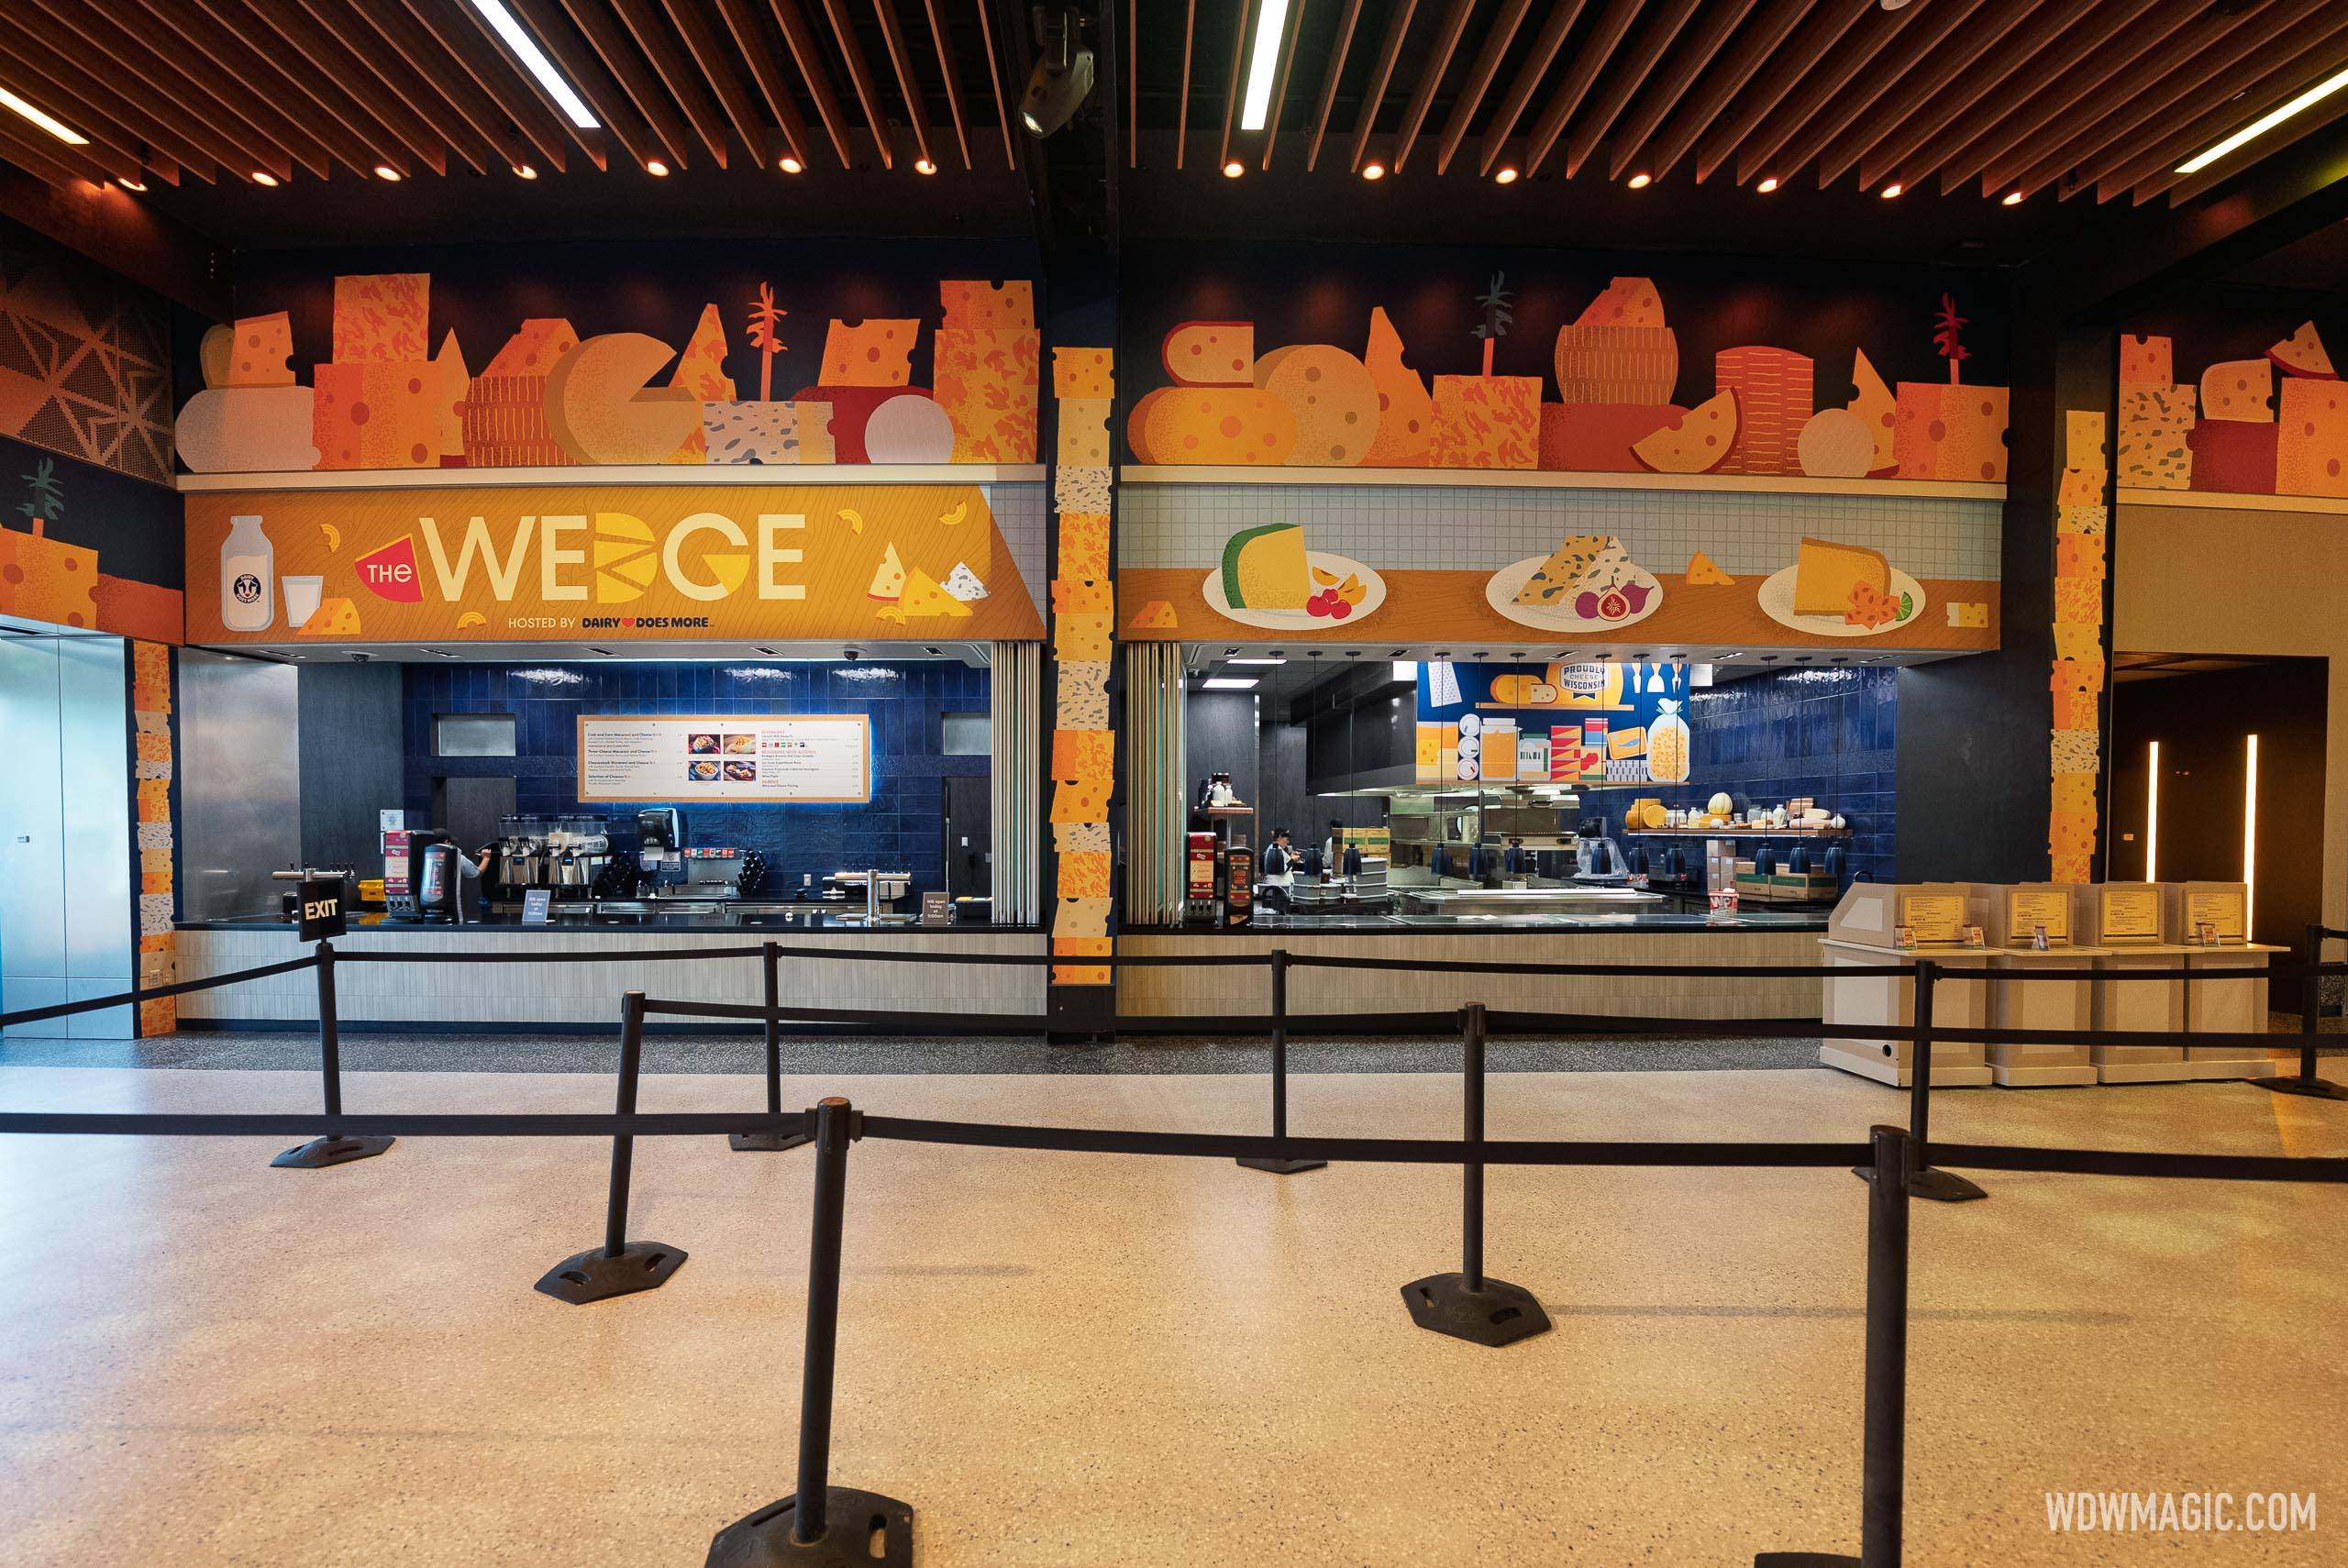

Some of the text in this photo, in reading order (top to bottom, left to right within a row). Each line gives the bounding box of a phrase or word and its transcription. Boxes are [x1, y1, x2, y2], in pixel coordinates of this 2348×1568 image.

[419, 512, 806, 604] WEDGE
[509, 617, 576, 629] HOSTED BY
[582, 616, 709, 629] DAIRY DOES MORE
[1564, 664, 1605, 676] PROUDLY
[1564, 679, 1605, 690] WISCONSIN
[305, 899, 338, 921] EXIT
